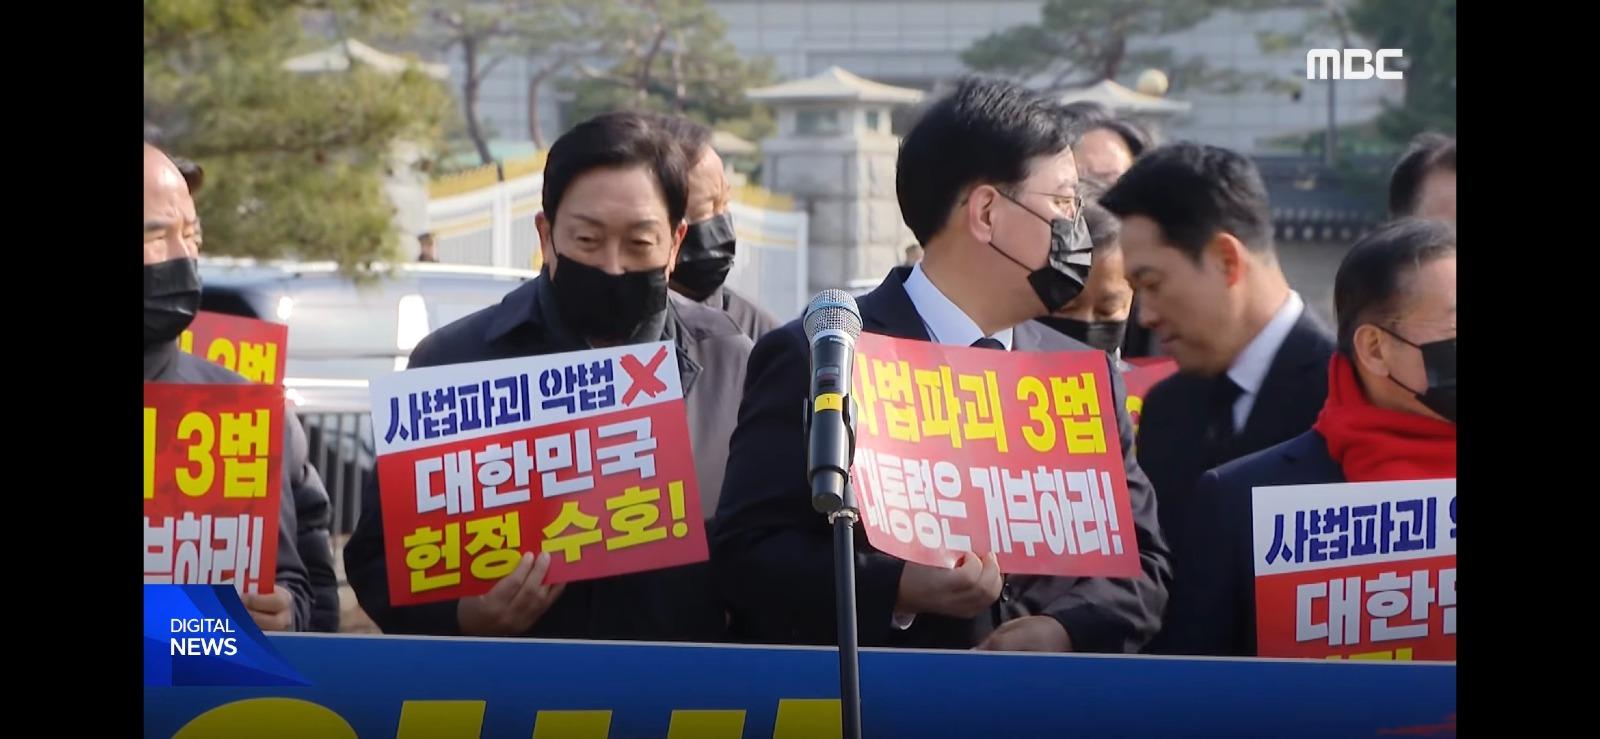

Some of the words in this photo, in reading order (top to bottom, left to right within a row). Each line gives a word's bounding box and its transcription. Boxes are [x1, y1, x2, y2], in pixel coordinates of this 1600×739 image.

[384, 373, 531, 444] 사법파괴
[539, 358, 616, 414] 악법
[852, 352, 1008, 453] 사법파괴
[1016, 372, 1107, 454] 3법
[175, 408, 271, 498] 3법
[415, 416, 657, 515] 대한민국
[853, 447, 972, 551] 대통령은
[969, 465, 1124, 556] 거부하라!
[403, 511, 522, 593] 헌정
[542, 480, 688, 563] 수호!
[1265, 496, 1437, 565] 사법파괴
